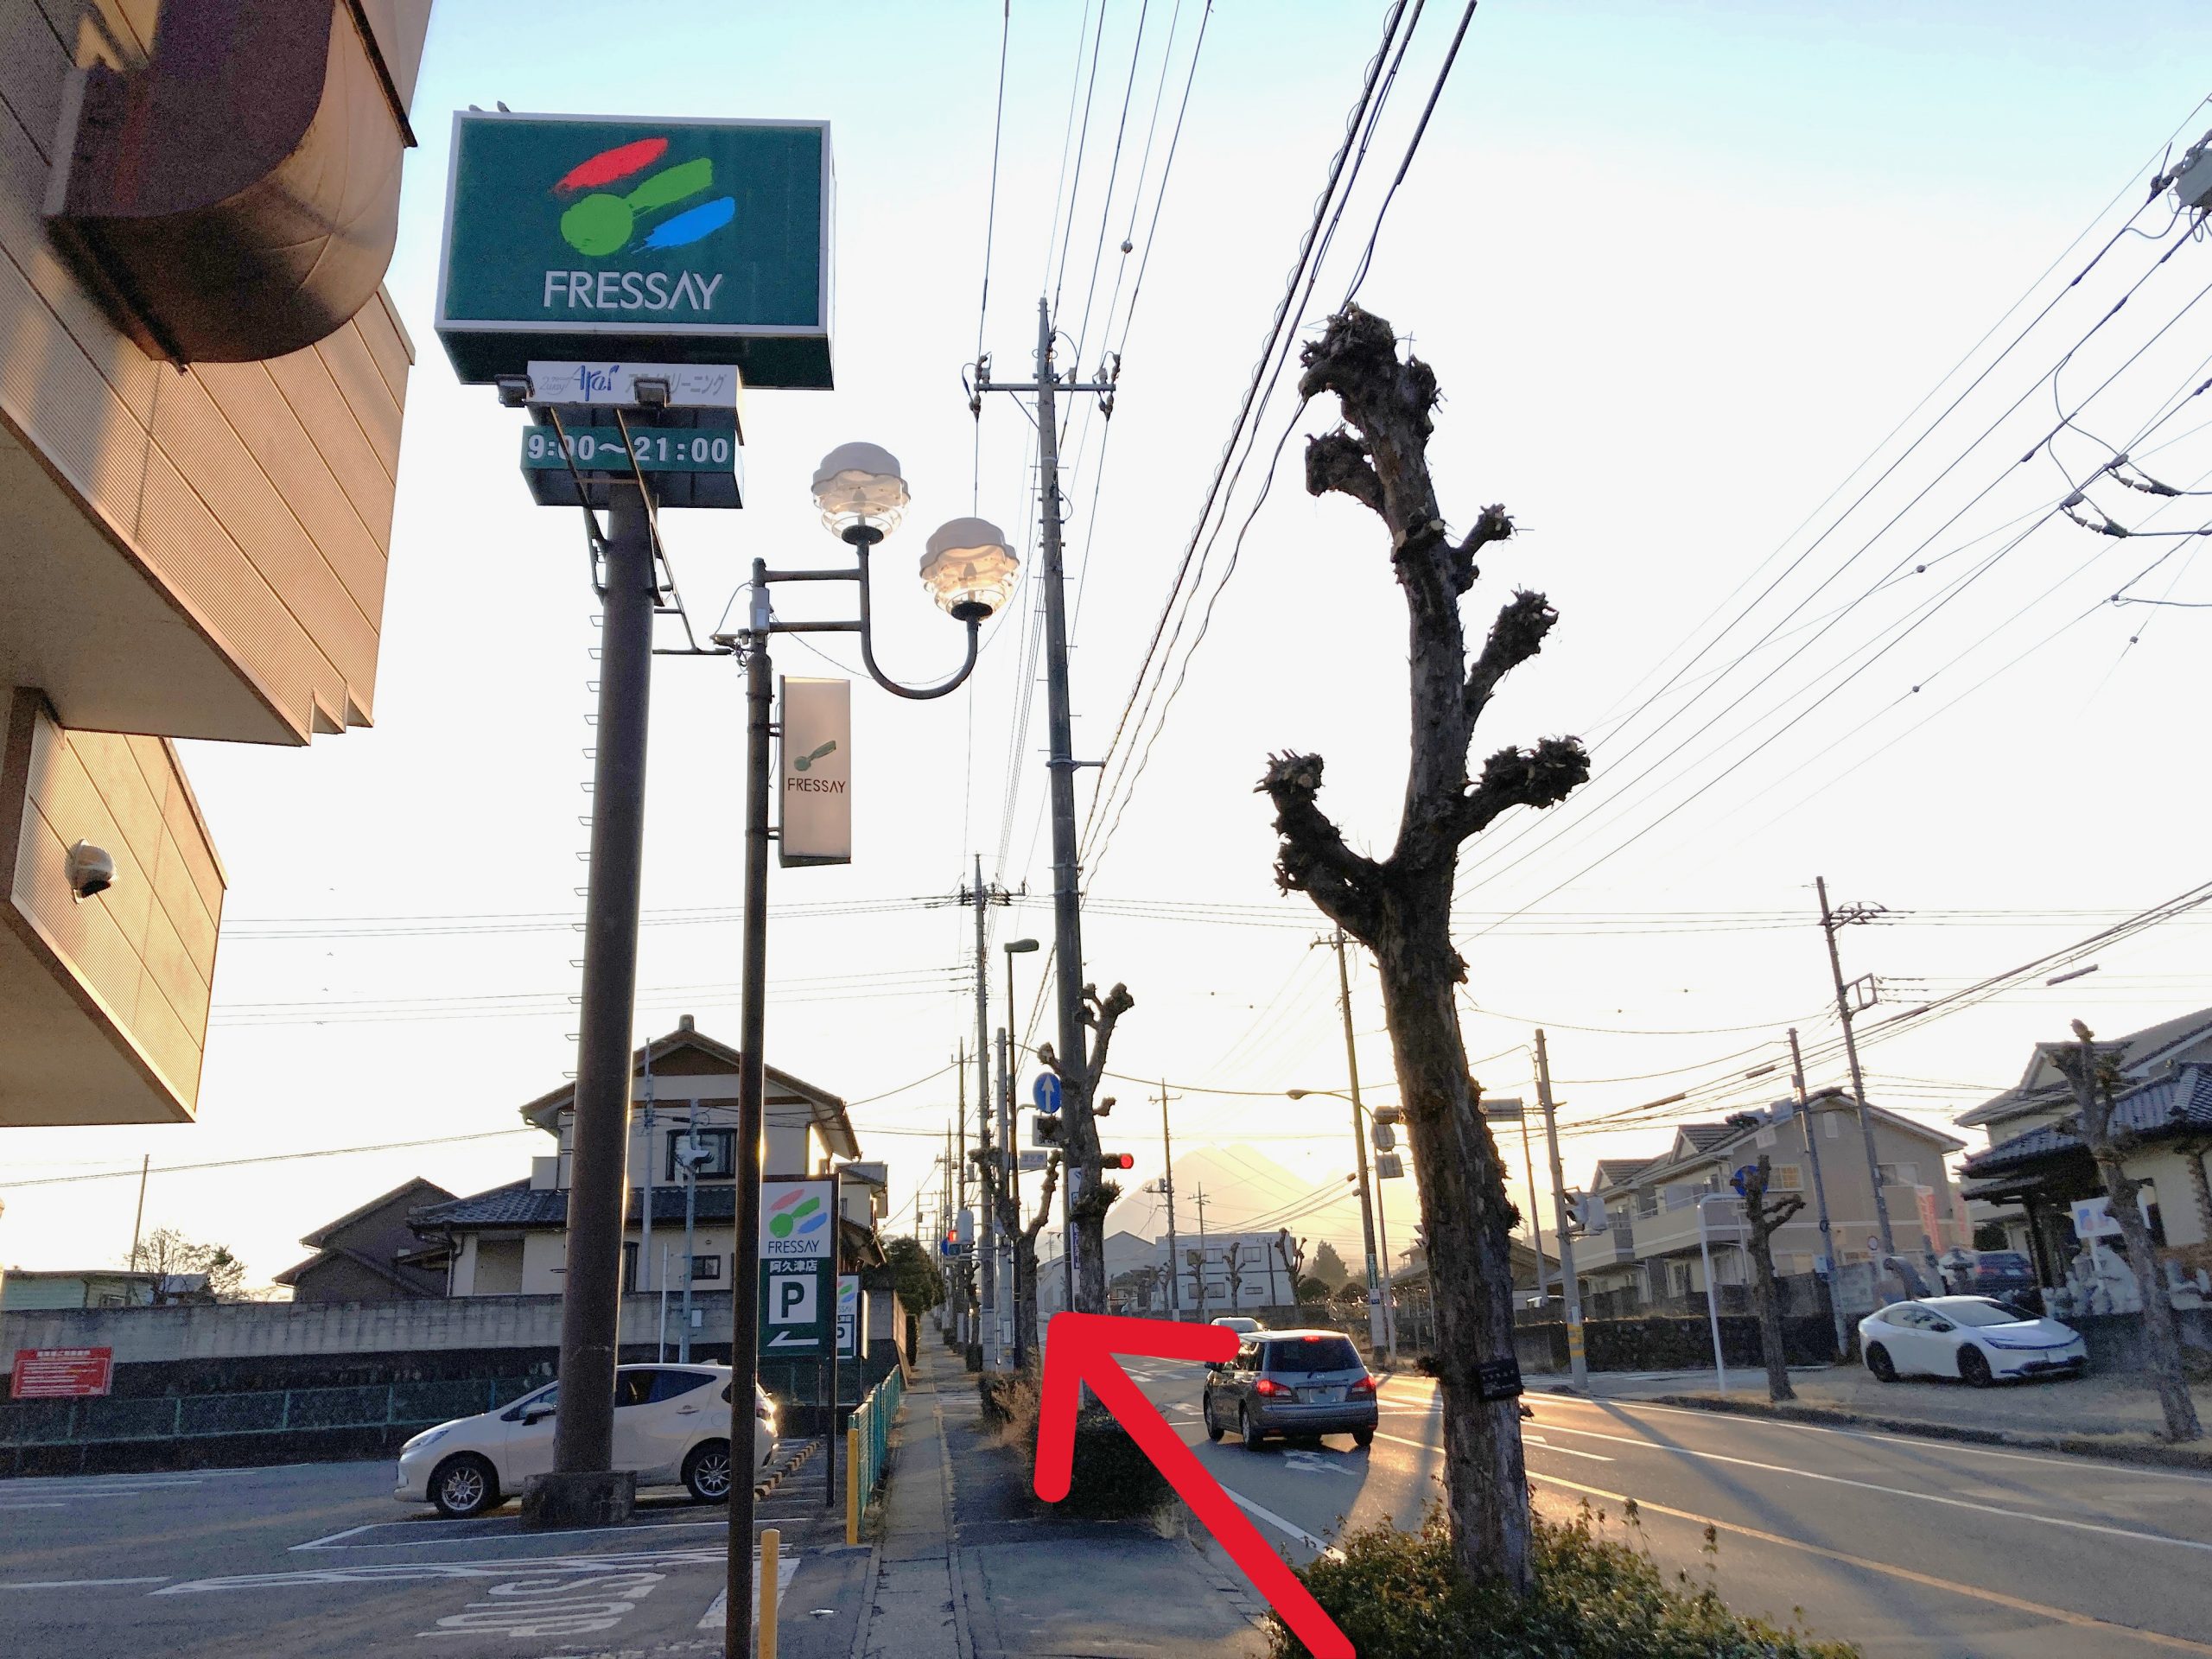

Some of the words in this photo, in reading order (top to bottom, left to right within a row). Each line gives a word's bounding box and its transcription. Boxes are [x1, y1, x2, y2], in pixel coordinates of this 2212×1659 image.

[543, 270, 723, 310] FRESSAY
[787, 778, 846, 794] FRESSAY
[768, 1240, 820, 1254] FRESSAY
[769, 1260, 818, 1274] 阿久津店
[781, 1281, 804, 1319] P
